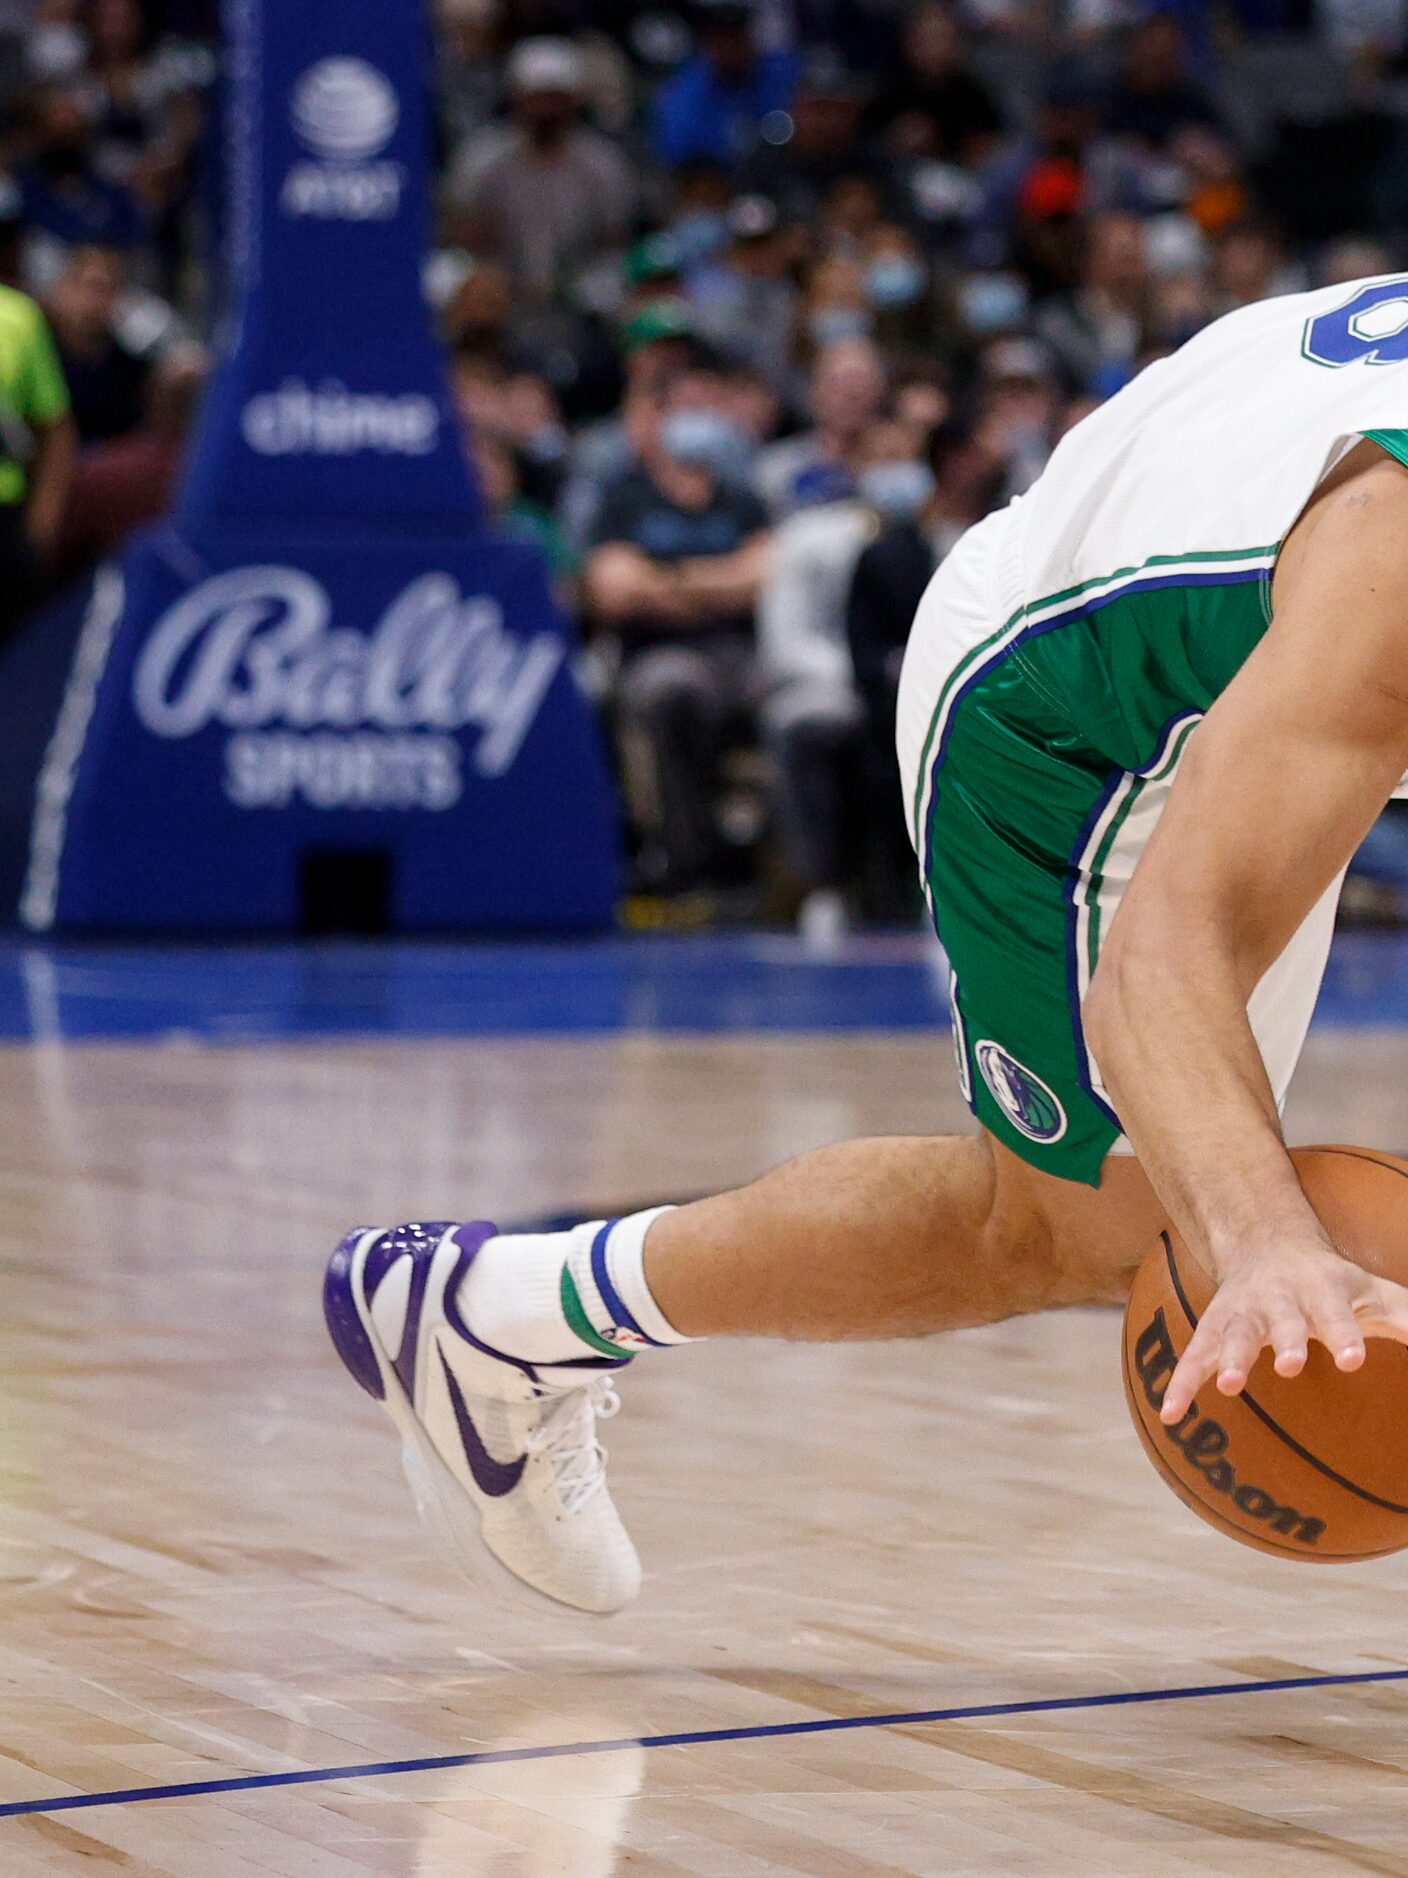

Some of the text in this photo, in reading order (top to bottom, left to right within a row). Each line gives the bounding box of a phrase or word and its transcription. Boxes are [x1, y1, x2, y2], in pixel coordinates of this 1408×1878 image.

[284, 162, 403, 219] AT&T
[241, 376, 439, 455] chime
[133, 564, 565, 777] Bally
[225, 731, 463, 809] SPORTS
[1134, 1306, 1327, 1545] Wilson
